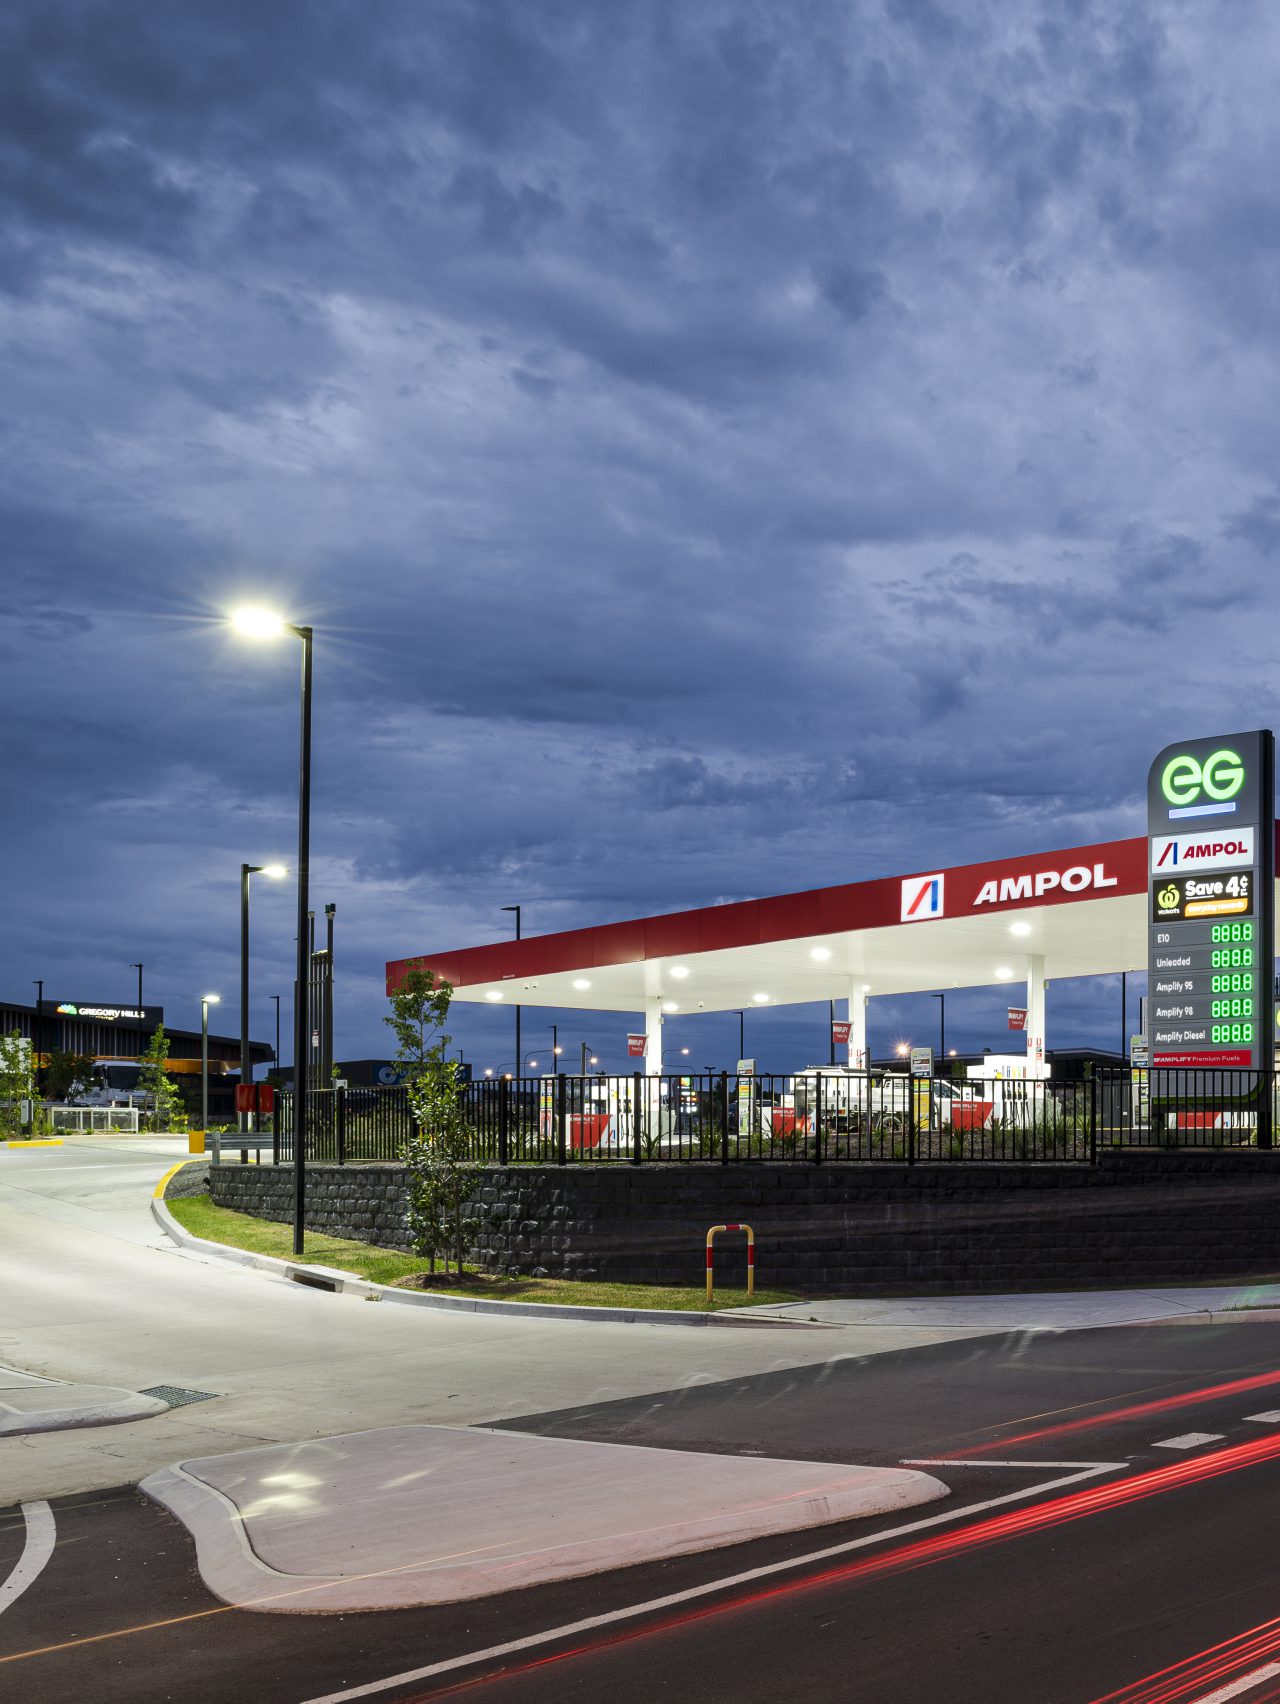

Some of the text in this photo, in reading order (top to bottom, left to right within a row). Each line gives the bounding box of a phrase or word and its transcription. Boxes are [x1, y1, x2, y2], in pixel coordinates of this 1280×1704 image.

[1183, 841, 1248, 859] AMPOL
[973, 863, 1118, 906] AMPOL
[1185, 880, 1224, 897] Save
[1157, 934, 1170, 943] E10
[1212, 924, 1252, 943] 888.8
[1156, 957, 1191, 967] Unleaded
[1212, 949, 1252, 968] 888.8
[1156, 981, 1193, 992] Amplify 95
[1212, 973, 1252, 993] 888.8
[1156, 1006, 1193, 1018] Amplify 98
[1212, 998, 1252, 1018] 888.8
[1156, 1030, 1206, 1042] Amplify Diesel
[1212, 1023, 1252, 1043] 888.8
